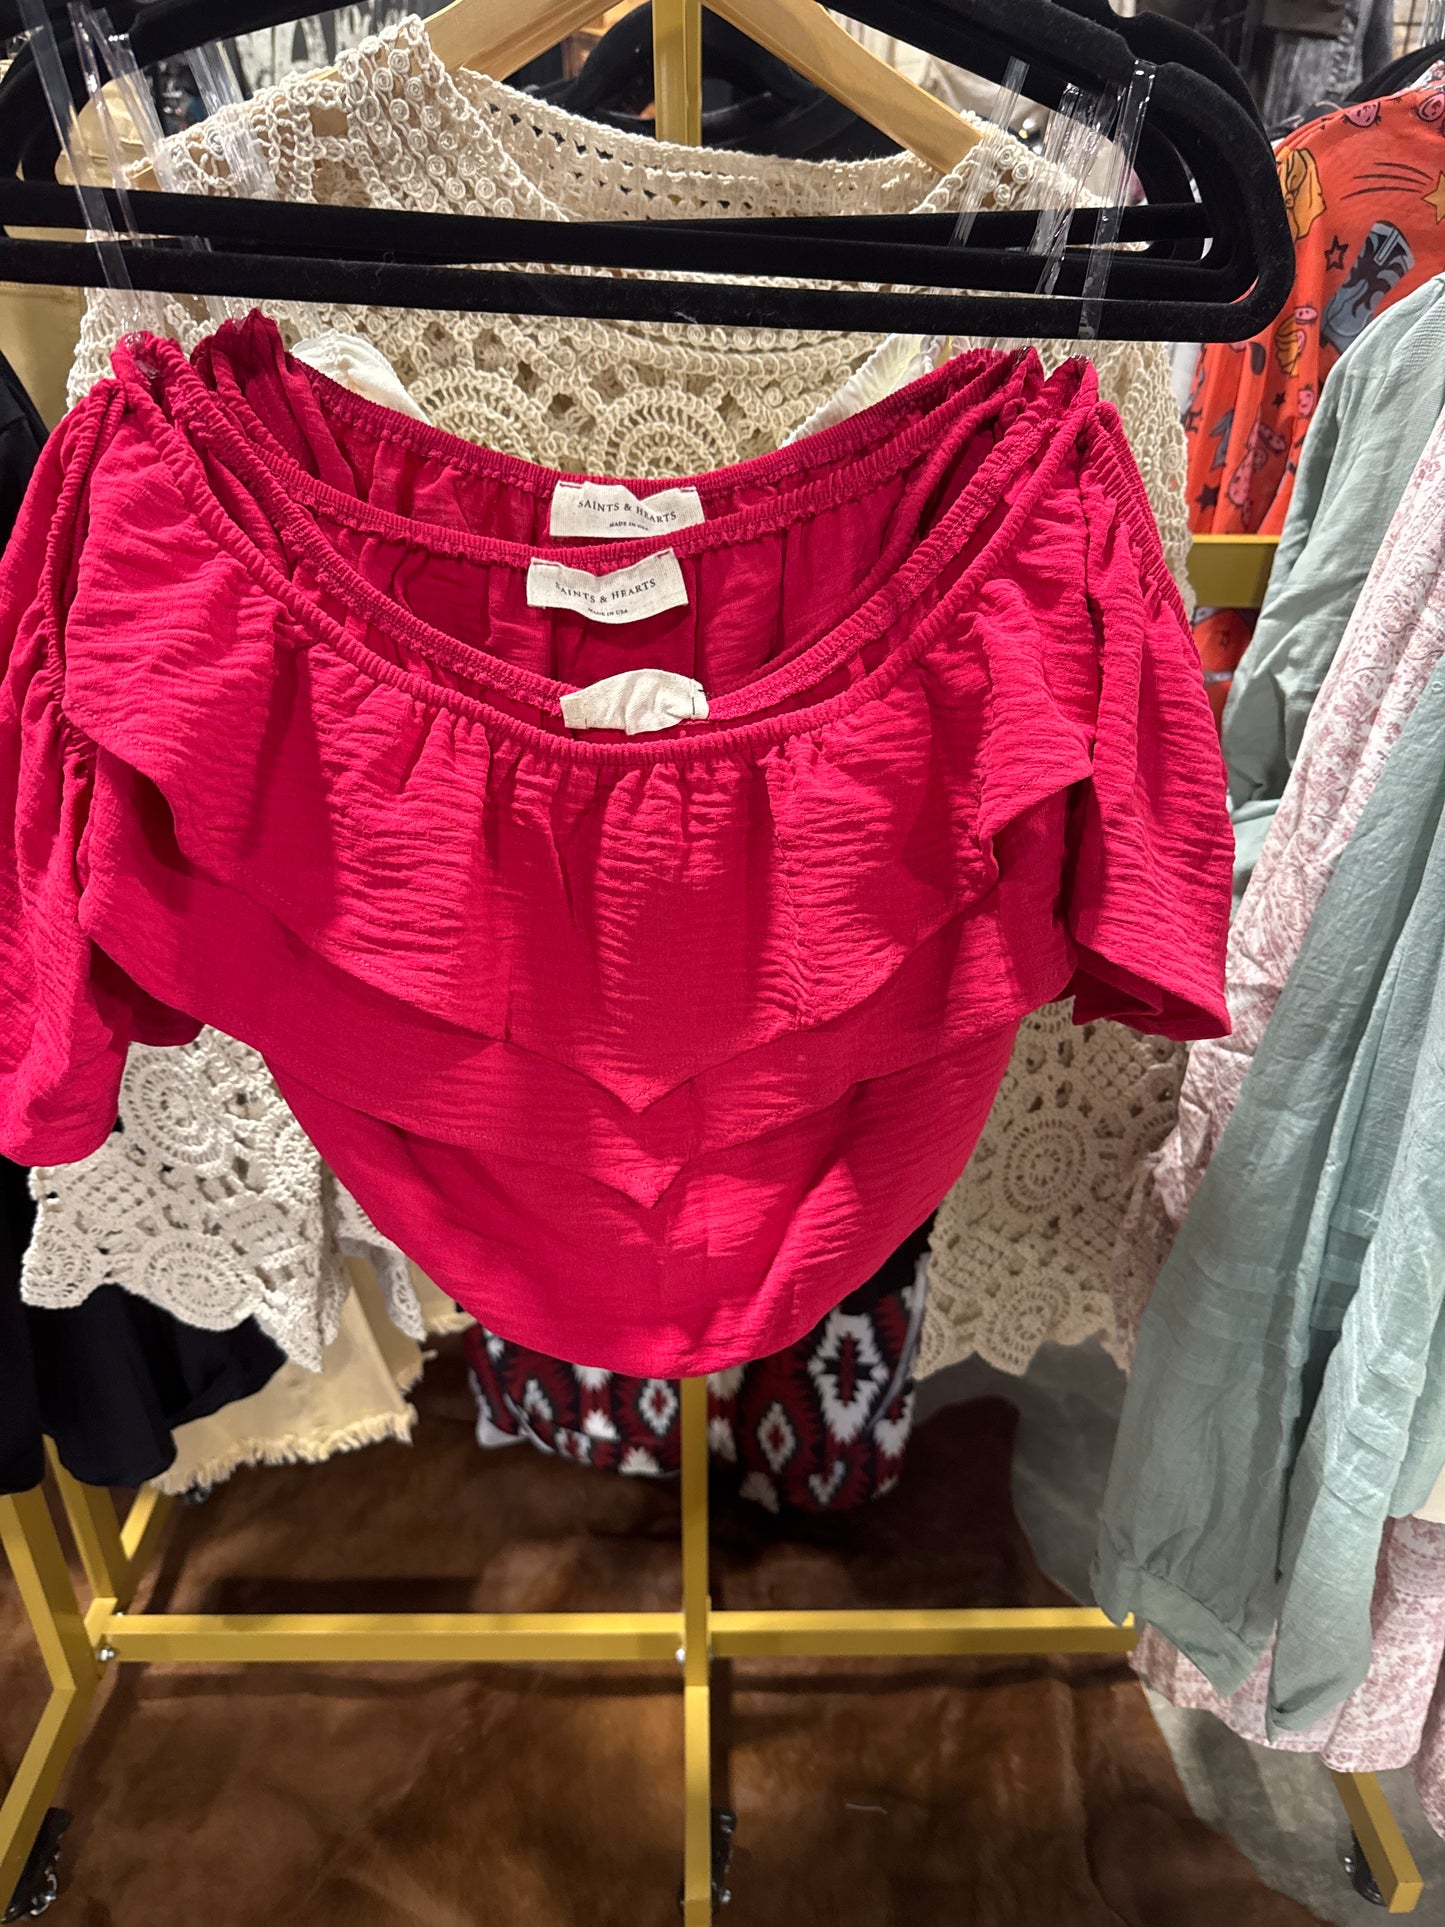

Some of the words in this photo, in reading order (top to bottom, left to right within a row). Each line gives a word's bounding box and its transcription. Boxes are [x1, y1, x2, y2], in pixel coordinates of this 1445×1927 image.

[578, 500, 620, 512] SAINTS
[624, 503, 631, 511] &
[636, 506, 677, 523] HEARTS
[555, 582, 596, 603] SAINTS
[611, 579, 656, 600] HEARTS
